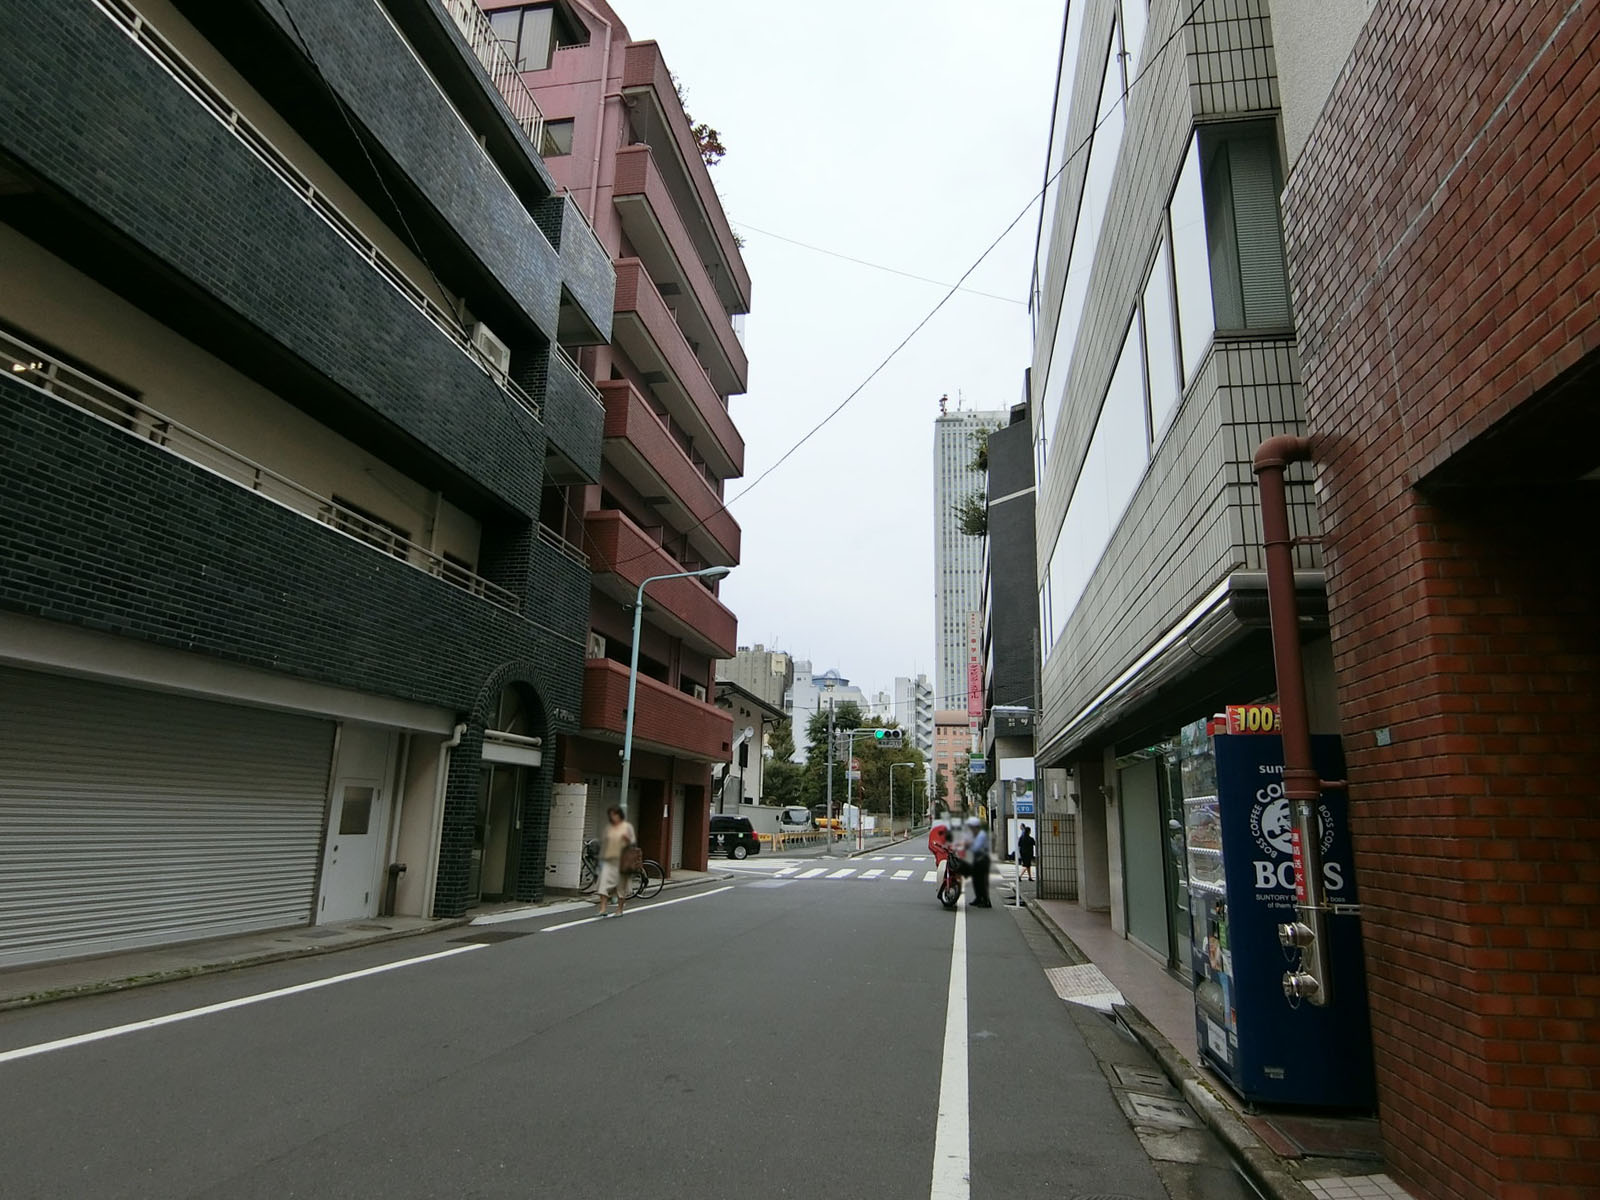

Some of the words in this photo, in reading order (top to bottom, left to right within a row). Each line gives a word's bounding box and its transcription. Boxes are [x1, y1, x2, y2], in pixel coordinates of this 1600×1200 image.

[1237, 707, 1273, 731] 100
[1250, 804, 1263, 837] COFFEE
[1318, 804, 1335, 828] BOSS
[1255, 837, 1278, 859] BOSS
[1253, 861, 1344, 890] BOS
